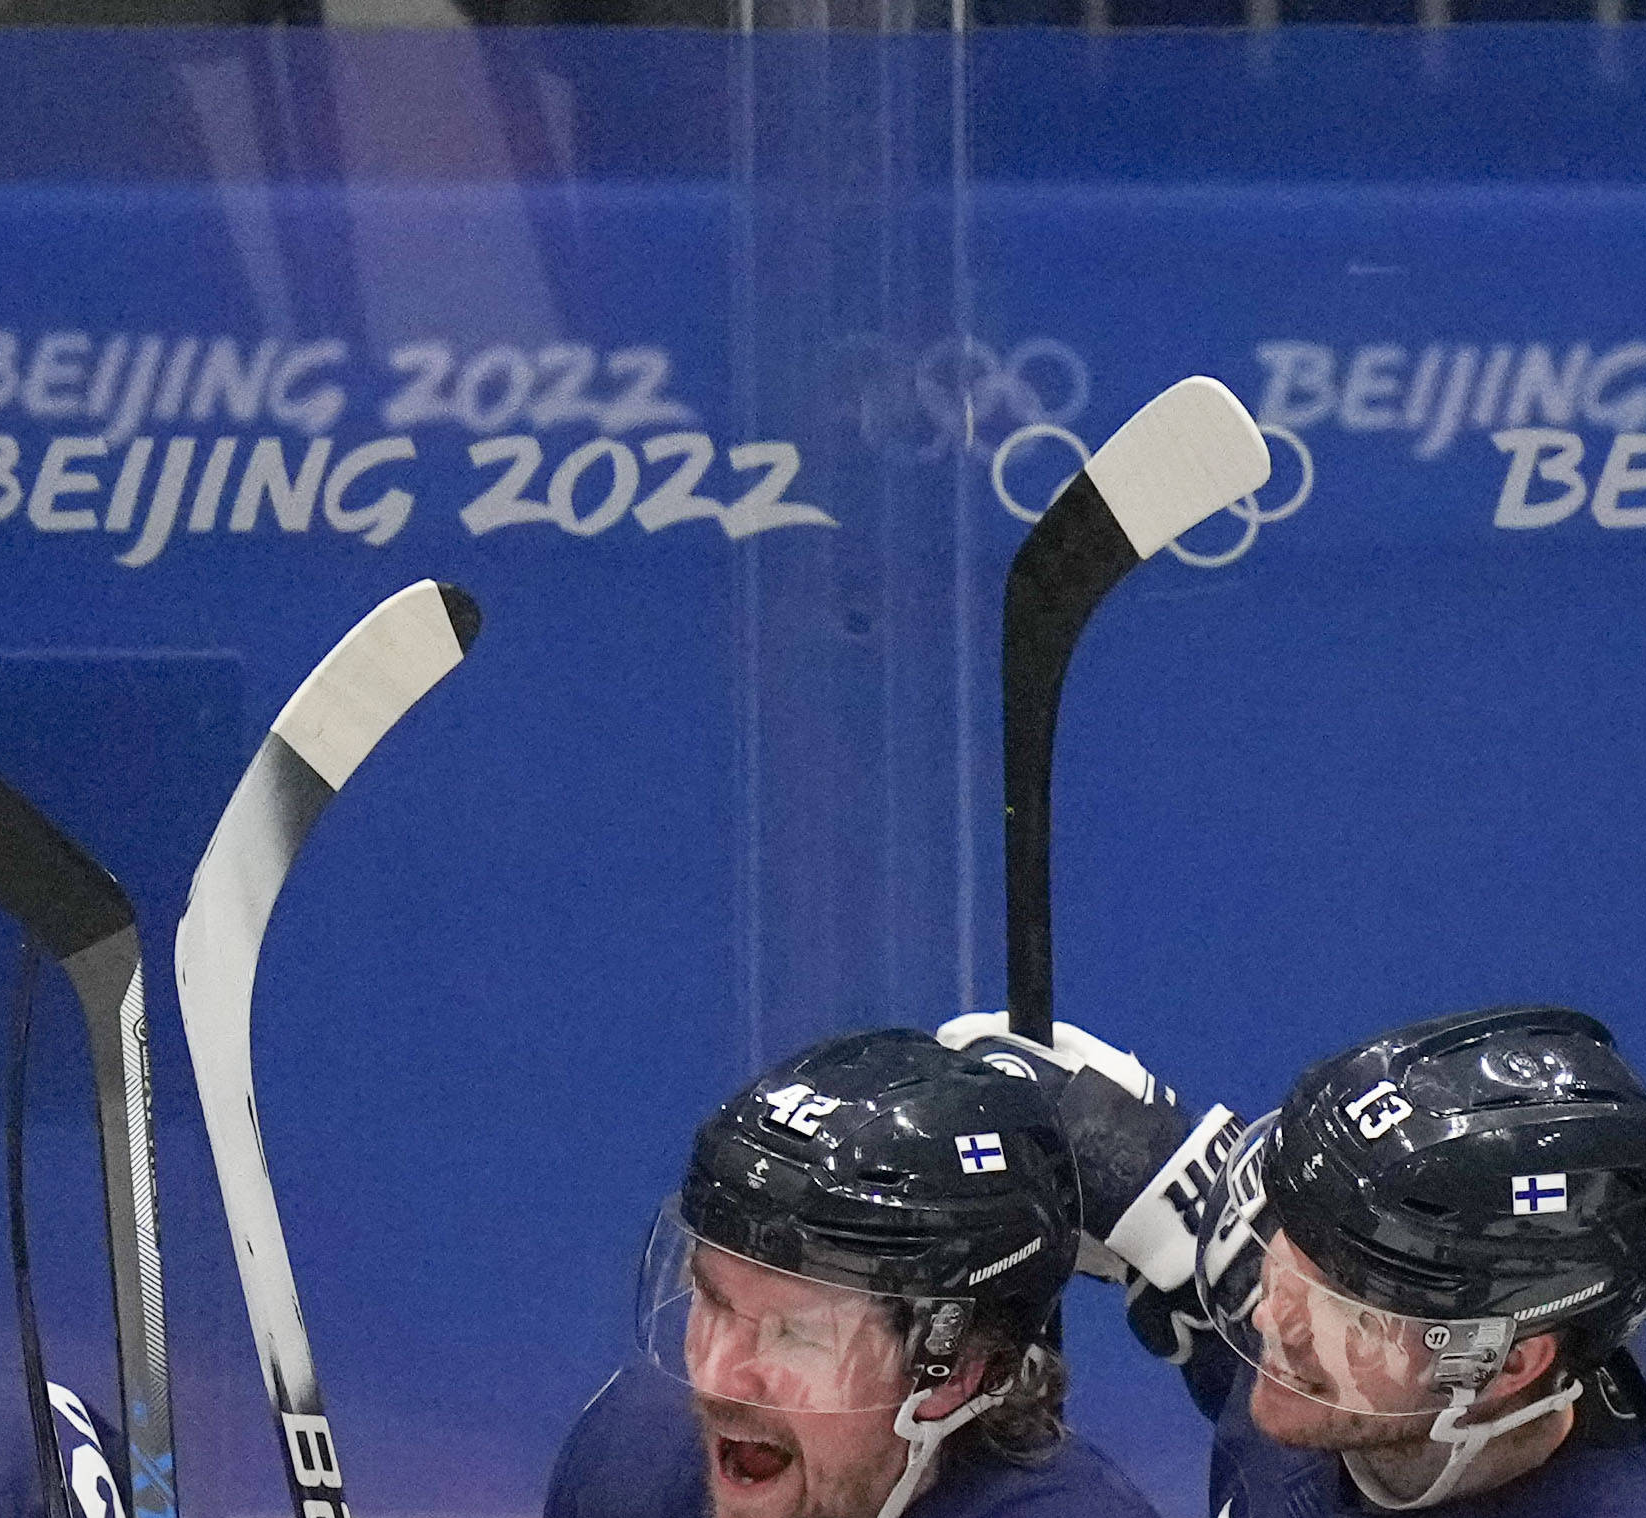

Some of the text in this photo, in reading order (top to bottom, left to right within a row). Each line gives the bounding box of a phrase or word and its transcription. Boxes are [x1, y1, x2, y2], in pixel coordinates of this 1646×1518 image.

[380, 340, 700, 434] 2022
[461, 431, 840, 538] 2022
[765, 1083, 841, 1136] 42
[1344, 1077, 1415, 1141] 13
[968, 1236, 1042, 1287] WARRIOR
[1513, 1280, 1606, 1322] WARRIOR
